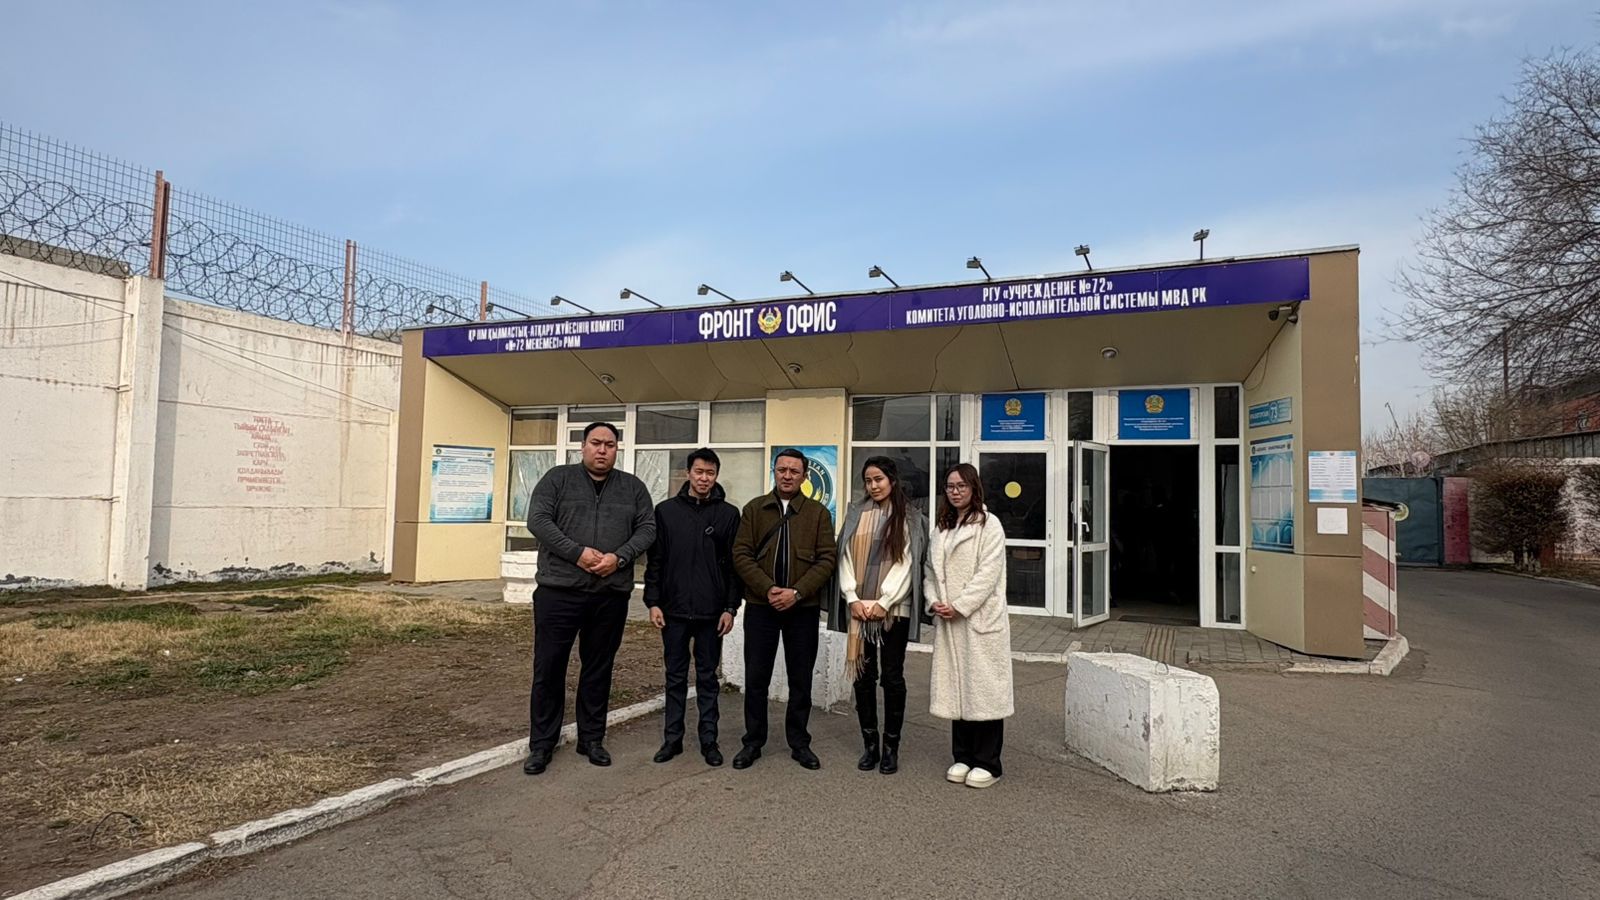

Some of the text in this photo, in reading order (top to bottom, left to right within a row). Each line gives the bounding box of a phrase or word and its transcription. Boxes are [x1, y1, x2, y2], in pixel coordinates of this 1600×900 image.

[983, 277, 1113, 302] РГУ «УЧРЕЖДЕНИЕ №72»
[906, 287, 1207, 325] КОМИТЕТА УГОЛОВНО-ИСПОЛНИТЕЛЬНОЙ СИСТЕМЫ МВД РК
[590, 319, 625, 334] КОМИТЕТІ
[698, 301, 837, 340] ФРОНТ ОФИС
[525, 337, 562, 350] МЕКЕМЕСІ»
[563, 335, 581, 348] РММ
